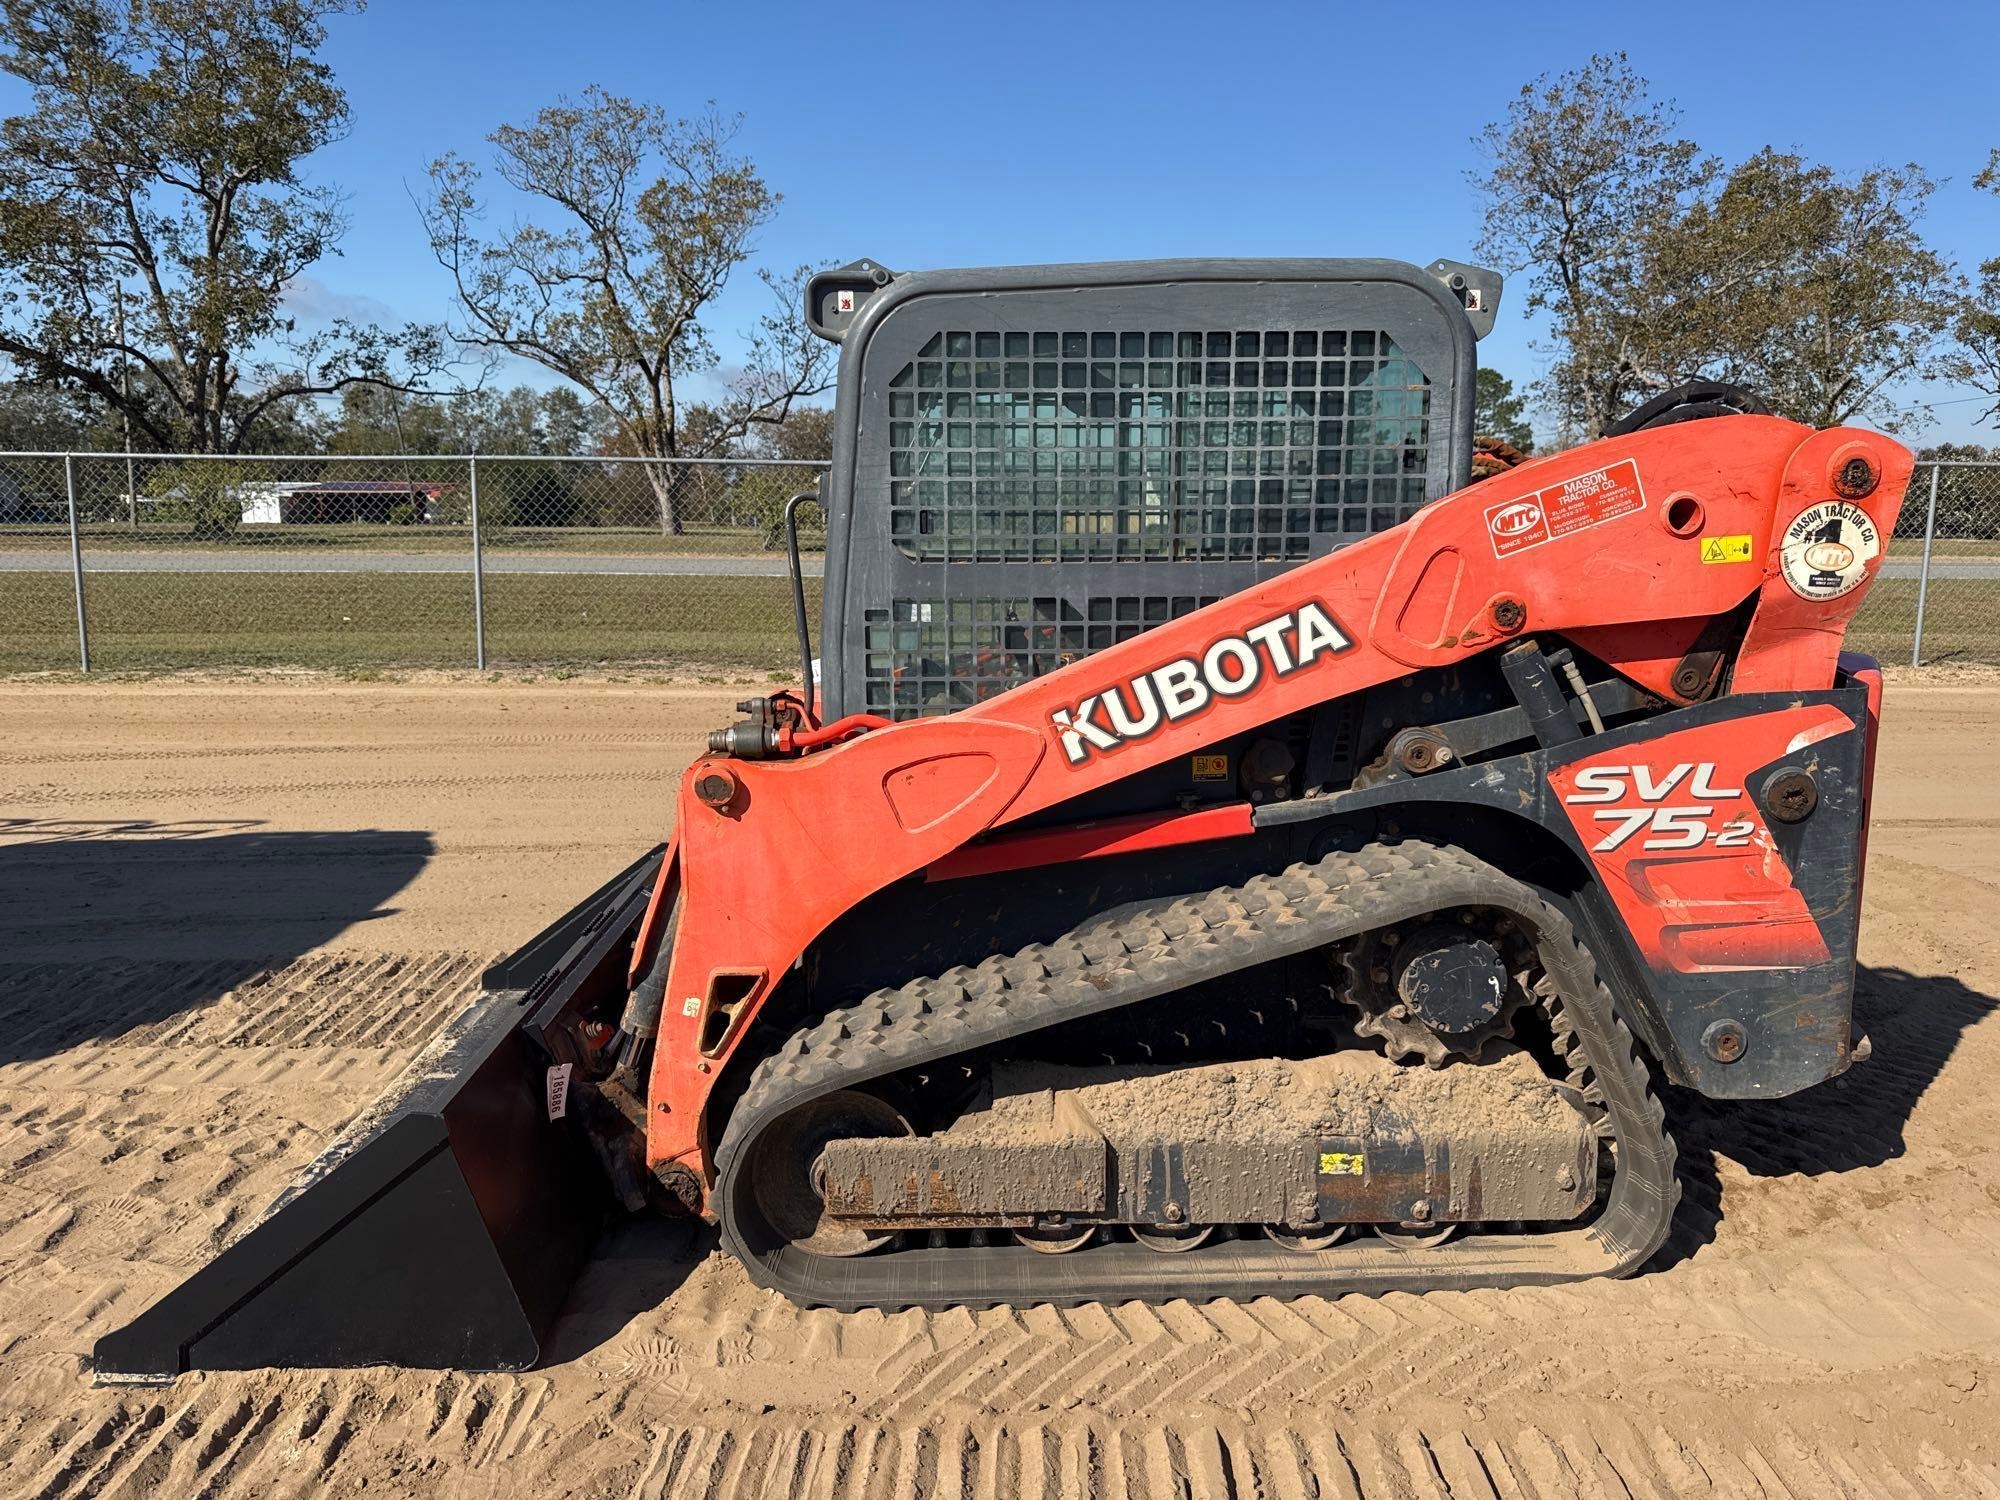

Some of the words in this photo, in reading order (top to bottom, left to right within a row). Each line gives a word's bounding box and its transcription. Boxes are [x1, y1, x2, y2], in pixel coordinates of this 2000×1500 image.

[1558, 483, 1600, 506] TRACTOR
[1601, 479, 1618, 491] CO.
[1563, 471, 1608, 495] MASON
[1499, 506, 1537, 532] MTC
[1790, 508, 1822, 540] MASON
[1824, 504, 1866, 530] TRACTOR
[1861, 527, 1874, 546] CO.
[1811, 549, 1851, 567] MTC
[1051, 603, 1350, 764] KUBOTA
[1565, 762, 1743, 805] SVL
[1591, 805, 1755, 852] 75-2
[551, 1074, 566, 1113] 185886
